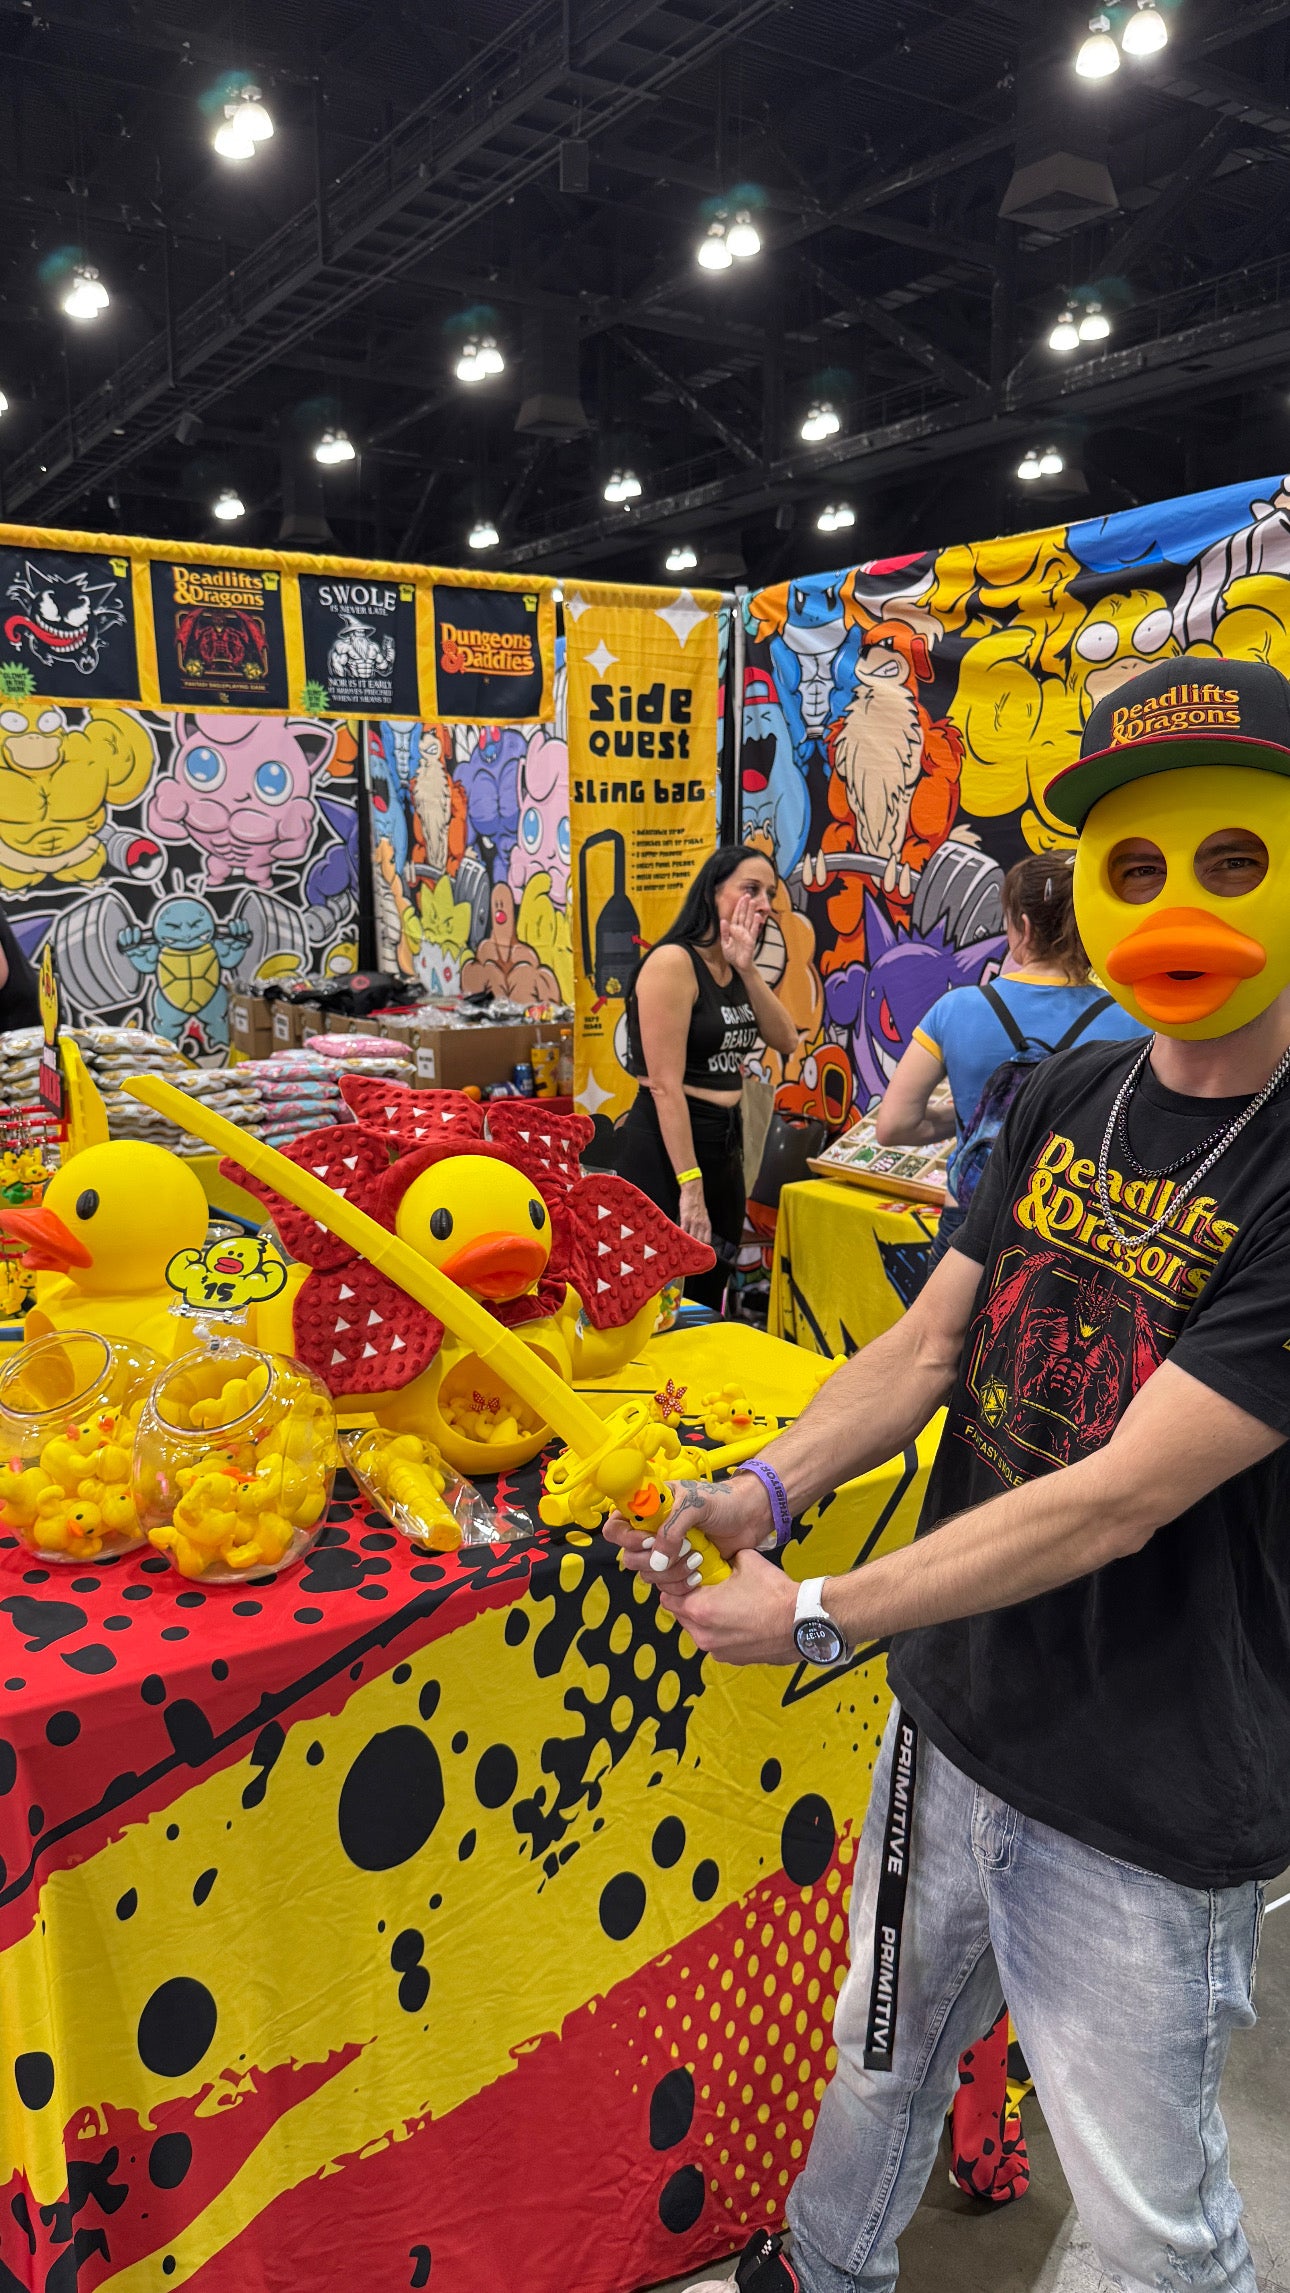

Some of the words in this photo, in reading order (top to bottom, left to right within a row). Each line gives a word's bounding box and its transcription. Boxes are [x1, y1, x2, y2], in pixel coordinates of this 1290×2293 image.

[172, 566, 263, 590] Deadlifts
[319, 584, 397, 611] SWOLE
[440, 622, 532, 652] Dungeons
[589, 683, 692, 724] Side
[1111, 683, 1240, 728] Deadlifts
[720, 1003, 756, 1025] BRAINS
[720, 1027, 758, 1051] BEAUT
[760, 1465, 790, 1524] EXHIBITOR
[887, 1725, 913, 1876] PRIMITIVE
